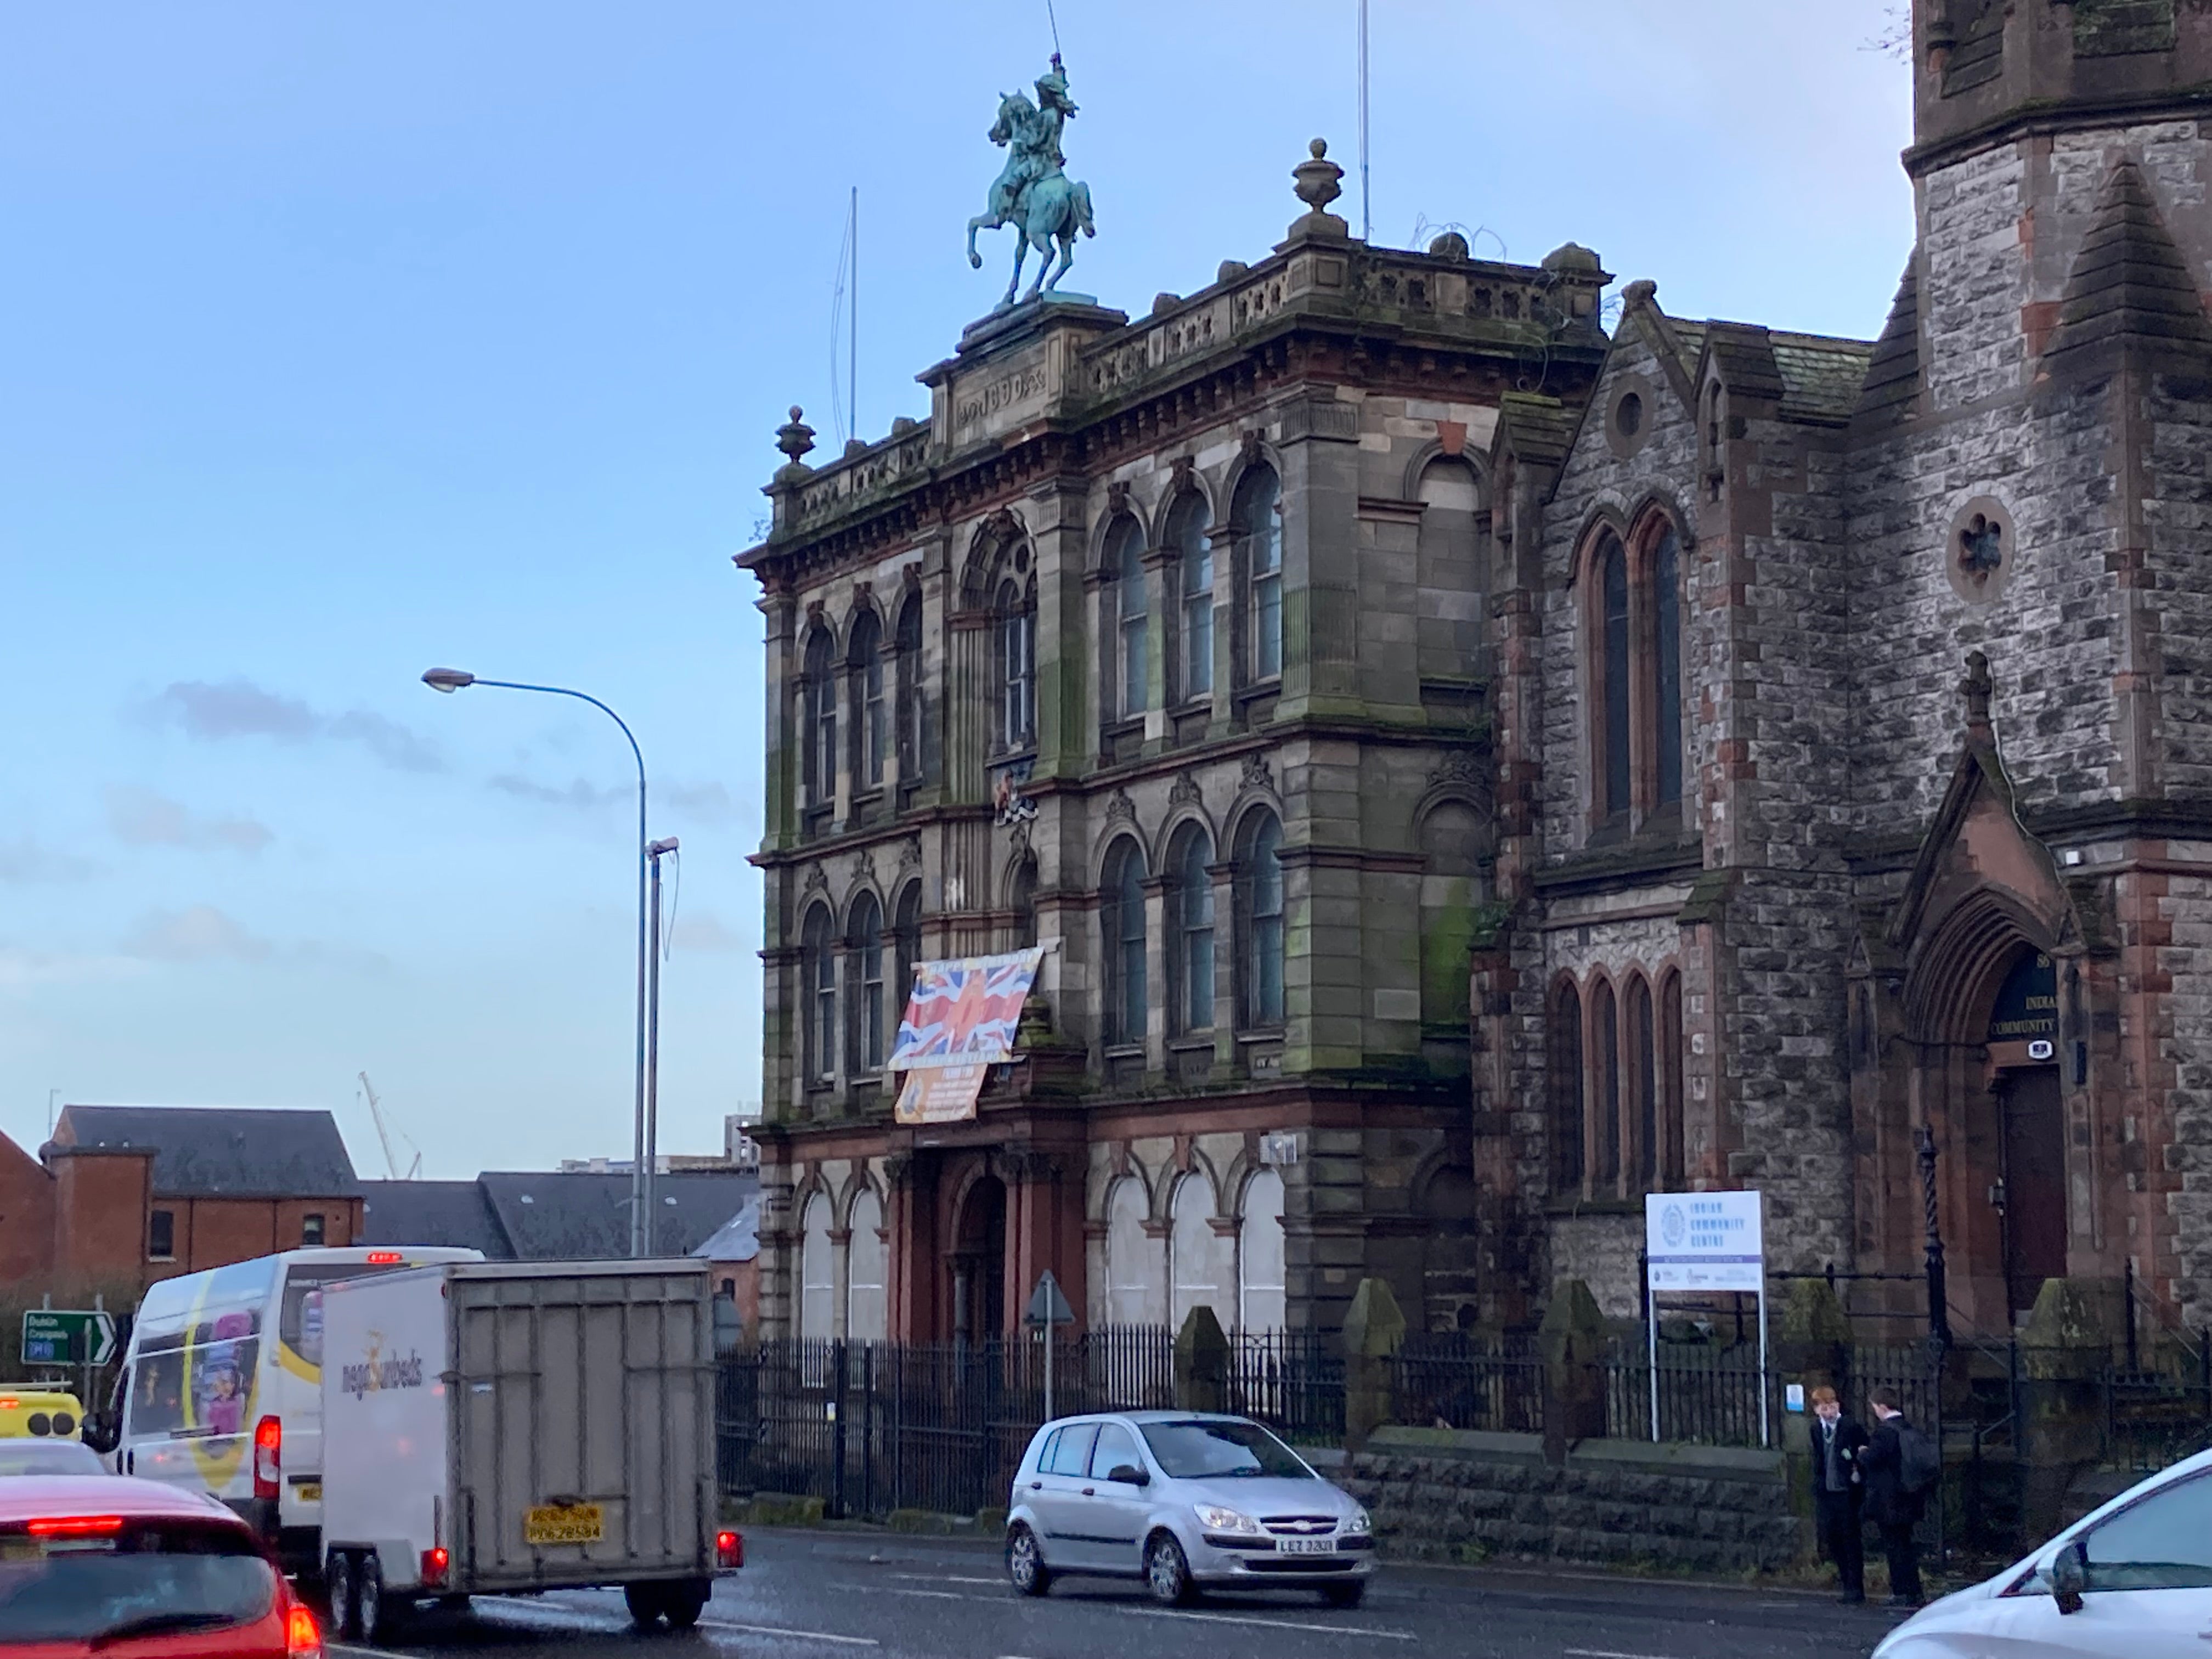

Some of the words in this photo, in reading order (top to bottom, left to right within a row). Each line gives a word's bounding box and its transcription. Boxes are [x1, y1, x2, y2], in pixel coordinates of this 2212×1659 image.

[2025, 995, 2058, 1010] INDIA
[1690, 1201, 1722, 1214] INDIAN
[1690, 1218, 1745, 1231] COMMUNITY
[1691, 1234, 1723, 1248] CENTRE
